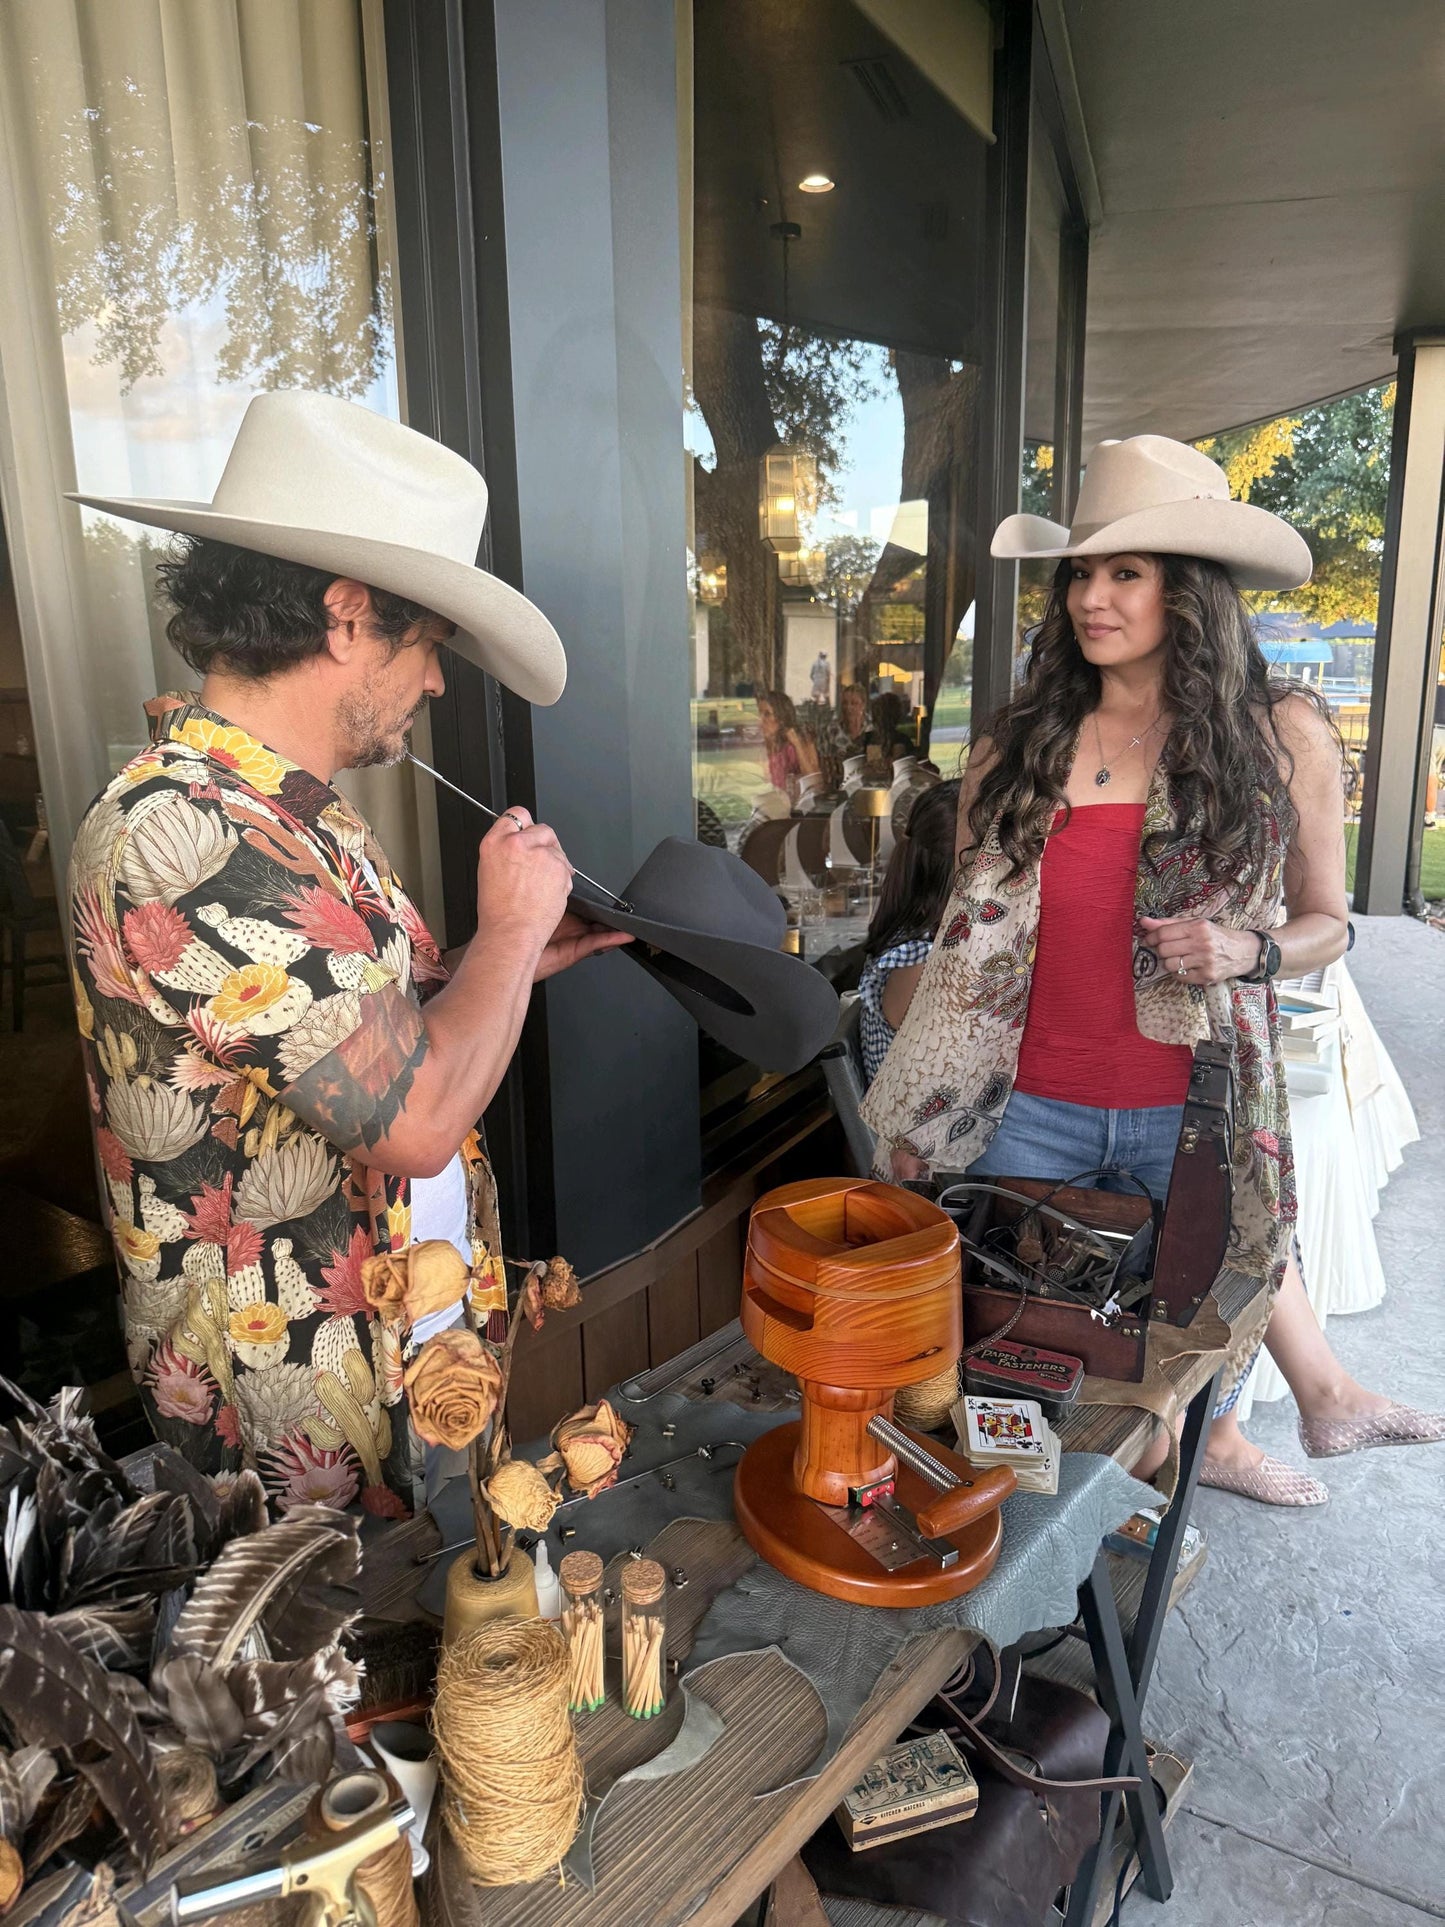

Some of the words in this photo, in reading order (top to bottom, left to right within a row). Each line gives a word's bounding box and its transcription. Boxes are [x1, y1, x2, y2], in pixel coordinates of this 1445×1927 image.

[981, 1348, 1018, 1362] PAPER
[998, 1358, 1066, 1373] FASTENERS
[1036, 1446, 1044, 1454] K
[880, 1808, 901, 1818] KITCHEN
[903, 1801, 925, 1812] MATCHES
